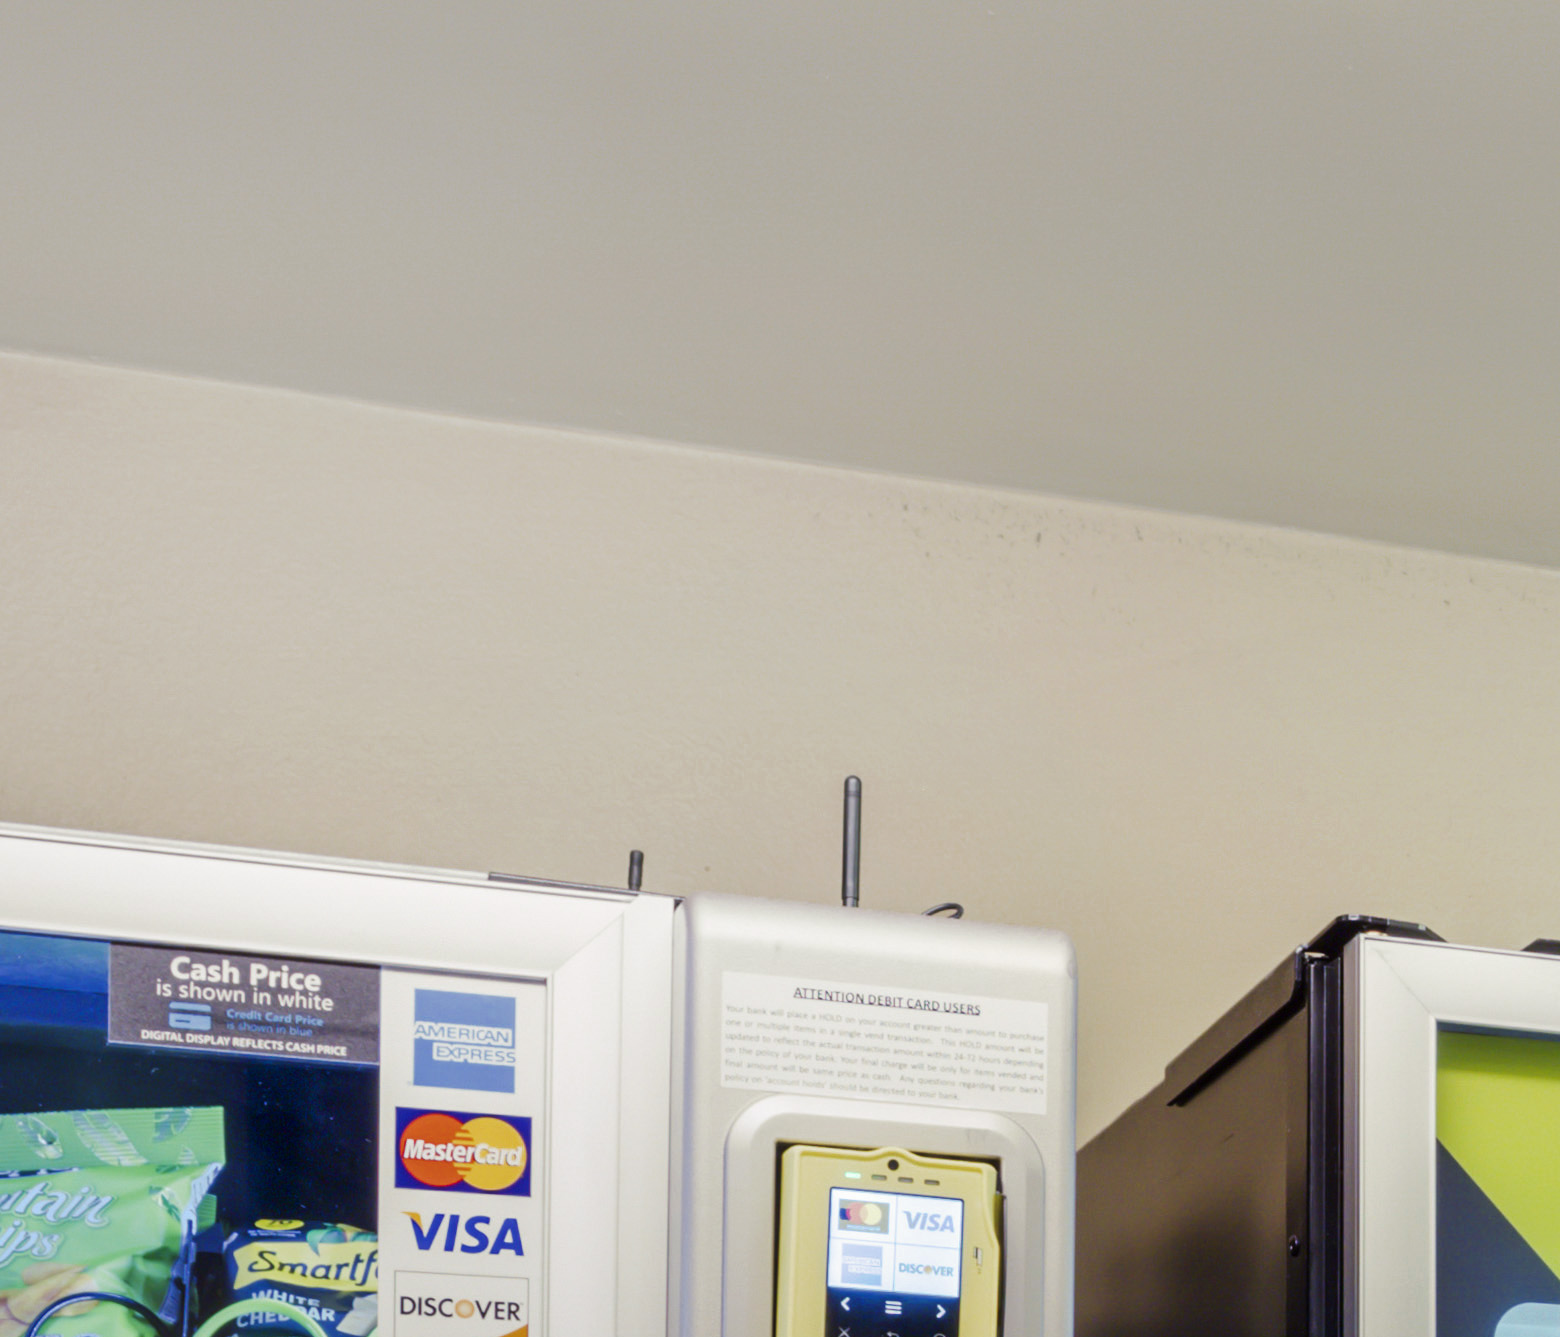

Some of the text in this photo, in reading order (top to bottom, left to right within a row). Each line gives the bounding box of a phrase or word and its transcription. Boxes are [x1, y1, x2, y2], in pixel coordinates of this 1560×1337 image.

[169, 956, 322, 992] Cash Price
[155, 980, 334, 1012] is shown in white
[793, 987, 981, 1016] ATTENTION DEBIT CARD USERS
[226, 1008, 325, 1028] Credit Card Price
[140, 1029, 347, 1057] DIGITAL DISPLAY REFLECTS CASH PRICE
[414, 1022, 511, 1045] AMERICAN
[435, 1046, 517, 1064] EXPRESS
[403, 1139, 524, 1167] MasterCard
[401, 1211, 525, 1257] VISA
[903, 1209, 956, 1234] VISA
[247, 1249, 378, 1287] Smartf
[898, 1261, 955, 1279] DISCOVER
[399, 1296, 522, 1322] DISCOVER
